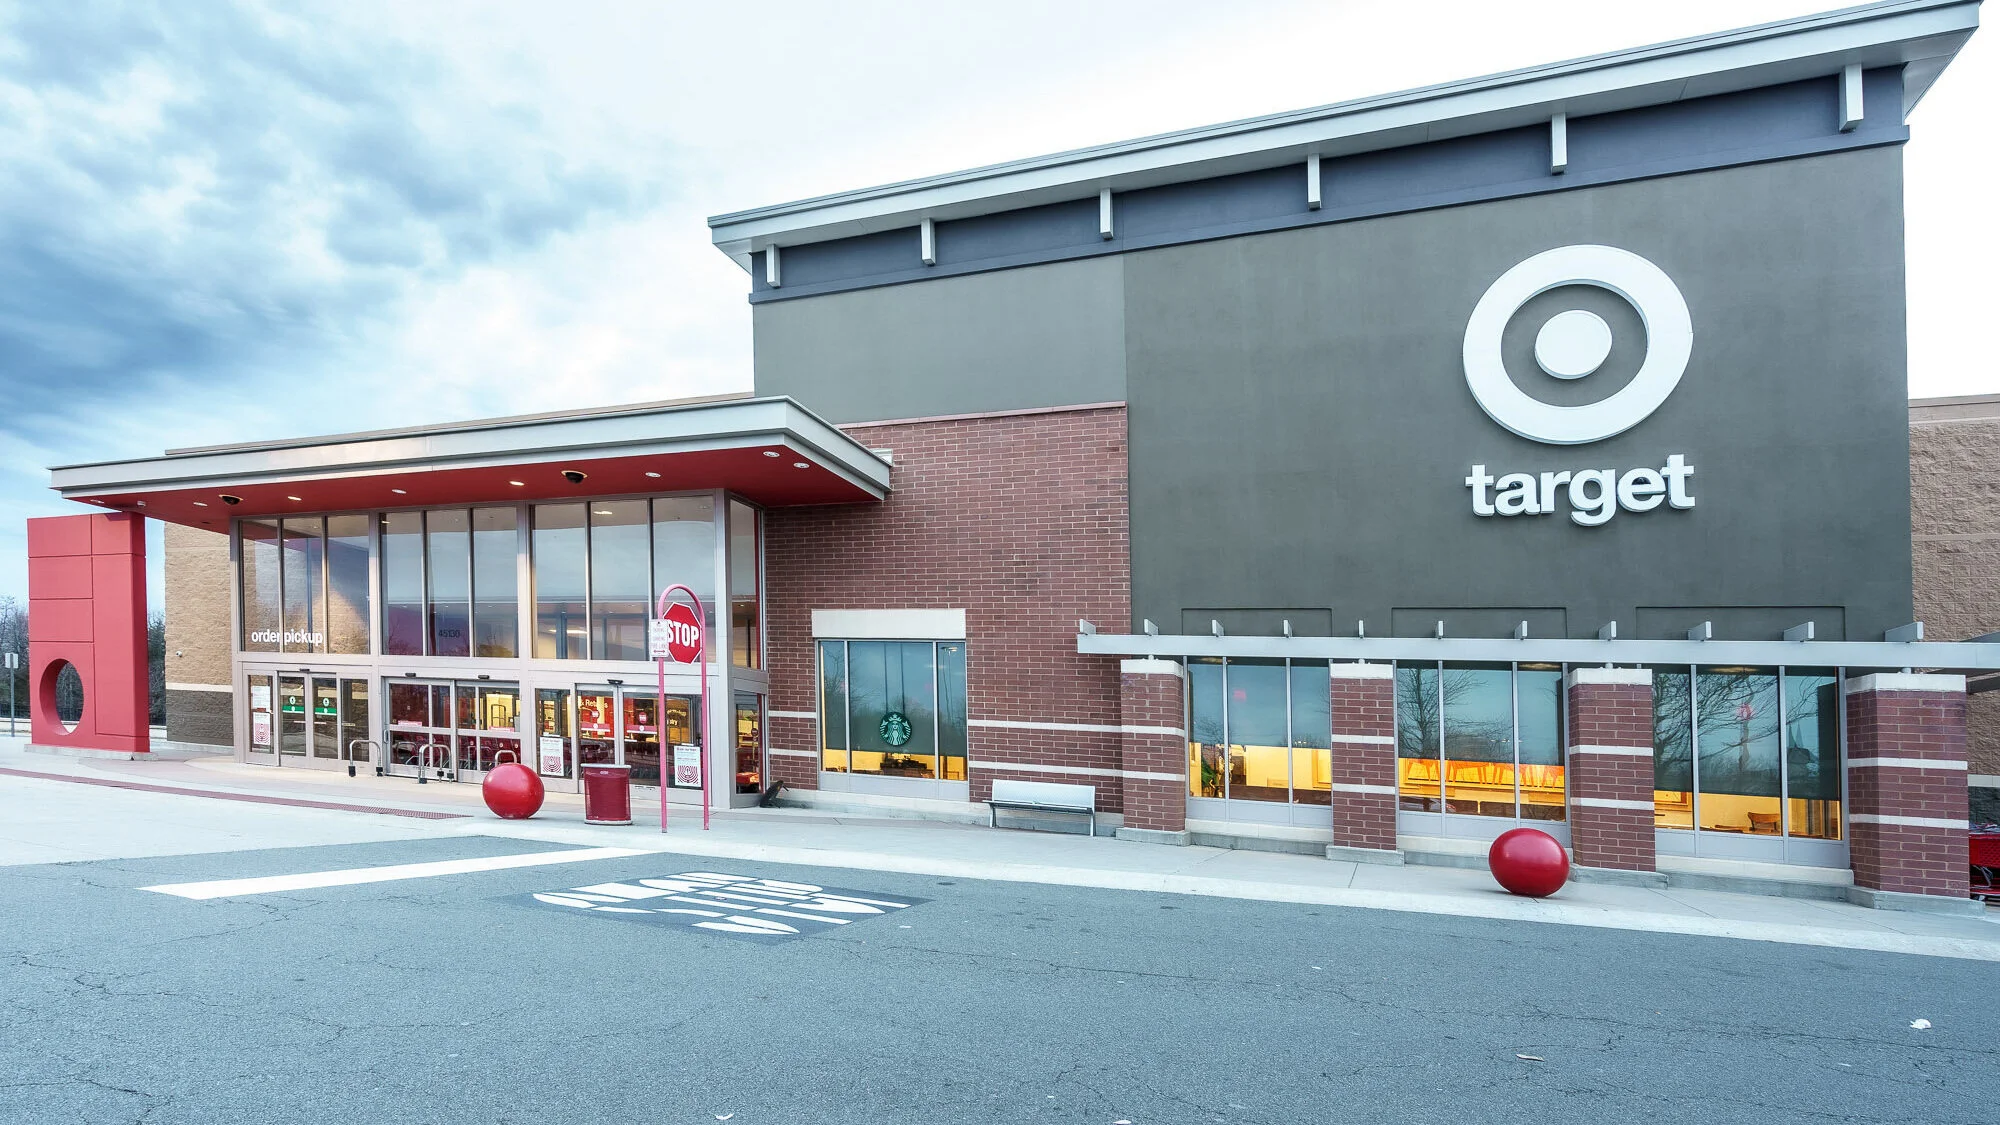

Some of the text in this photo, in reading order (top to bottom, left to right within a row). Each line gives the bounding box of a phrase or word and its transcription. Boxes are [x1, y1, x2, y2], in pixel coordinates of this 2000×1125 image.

[1465, 454, 1696, 527] target
[284, 628, 323, 646] pickup
[667, 619, 699, 648] STOP
[532, 871, 912, 935] STOP
